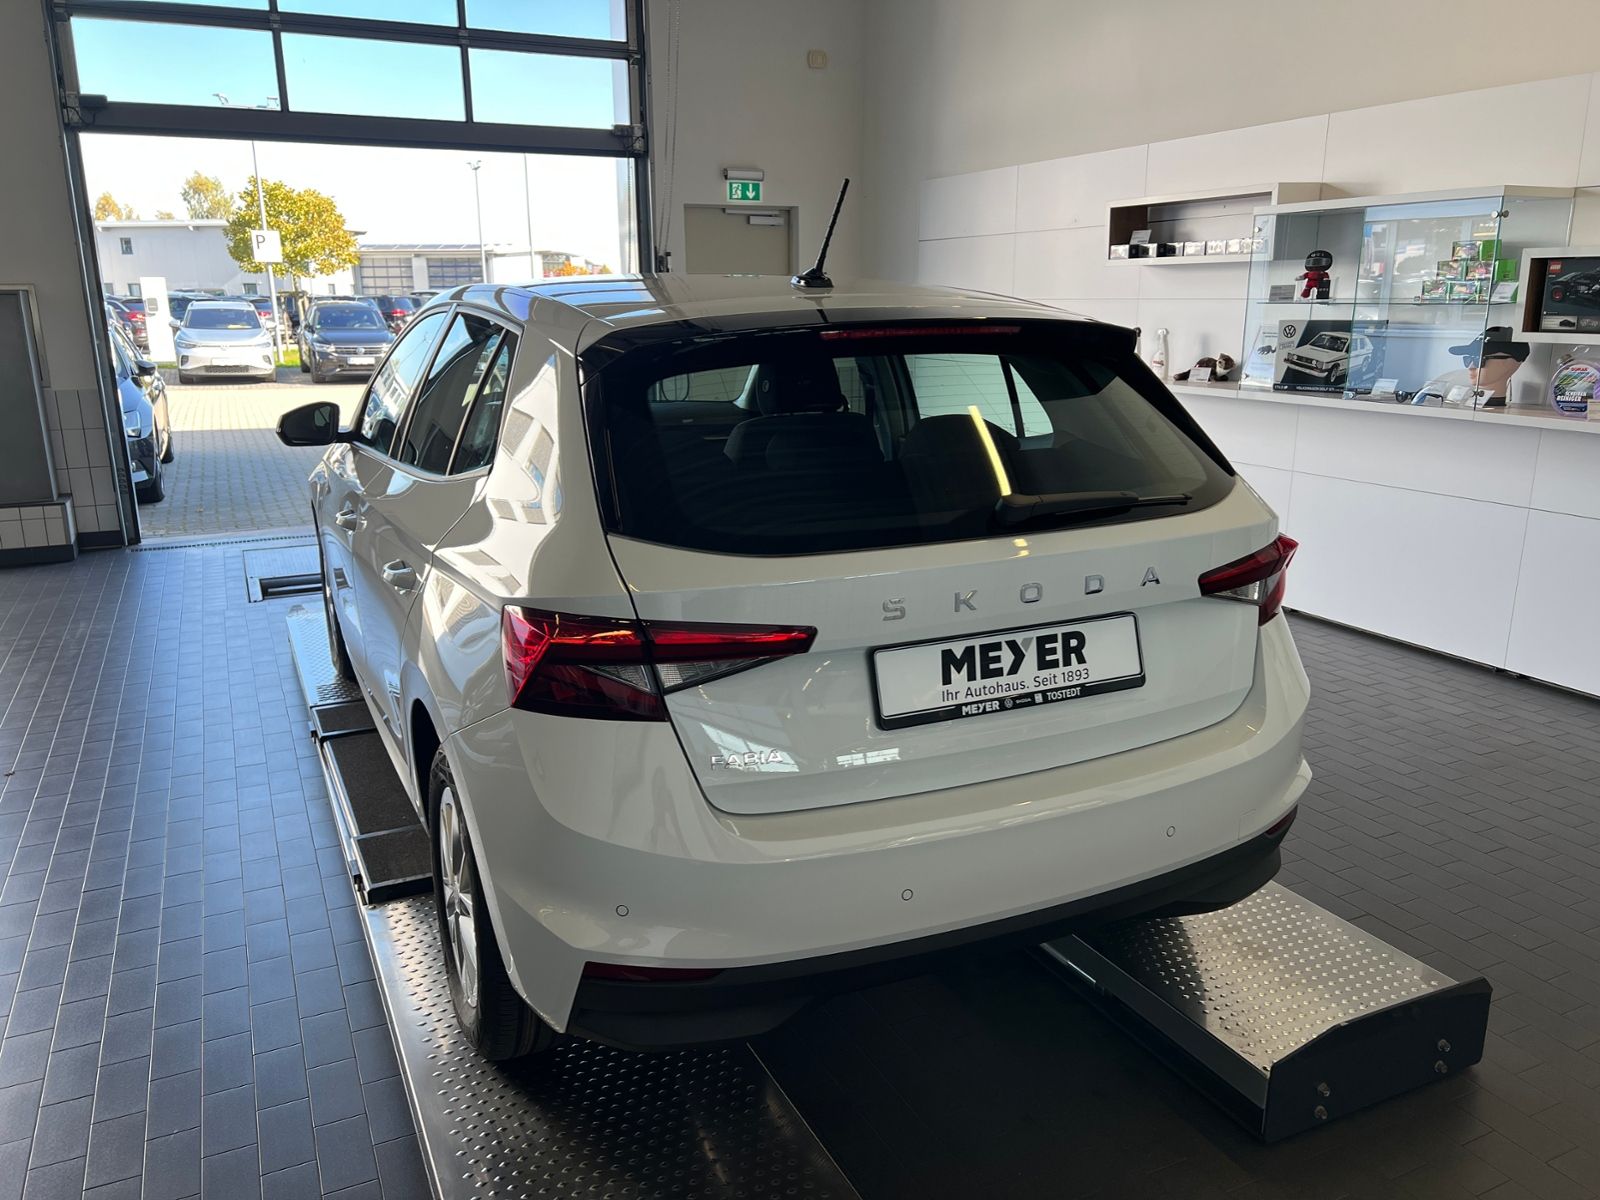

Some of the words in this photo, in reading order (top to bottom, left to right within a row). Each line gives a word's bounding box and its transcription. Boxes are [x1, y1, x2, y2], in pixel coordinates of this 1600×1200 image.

[256, 235, 265, 249] P
[941, 631, 1087, 686] MEYER
[942, 689, 960, 702] Ihr
[965, 681, 1030, 699] Autohaus.
[1033, 674, 1058, 688] Seit
[1061, 668, 1090, 684] 1893
[962, 700, 1000, 716] MEYER
[1046, 686, 1082, 701] TOSTEDT
[711, 749, 783, 769] FABIA
